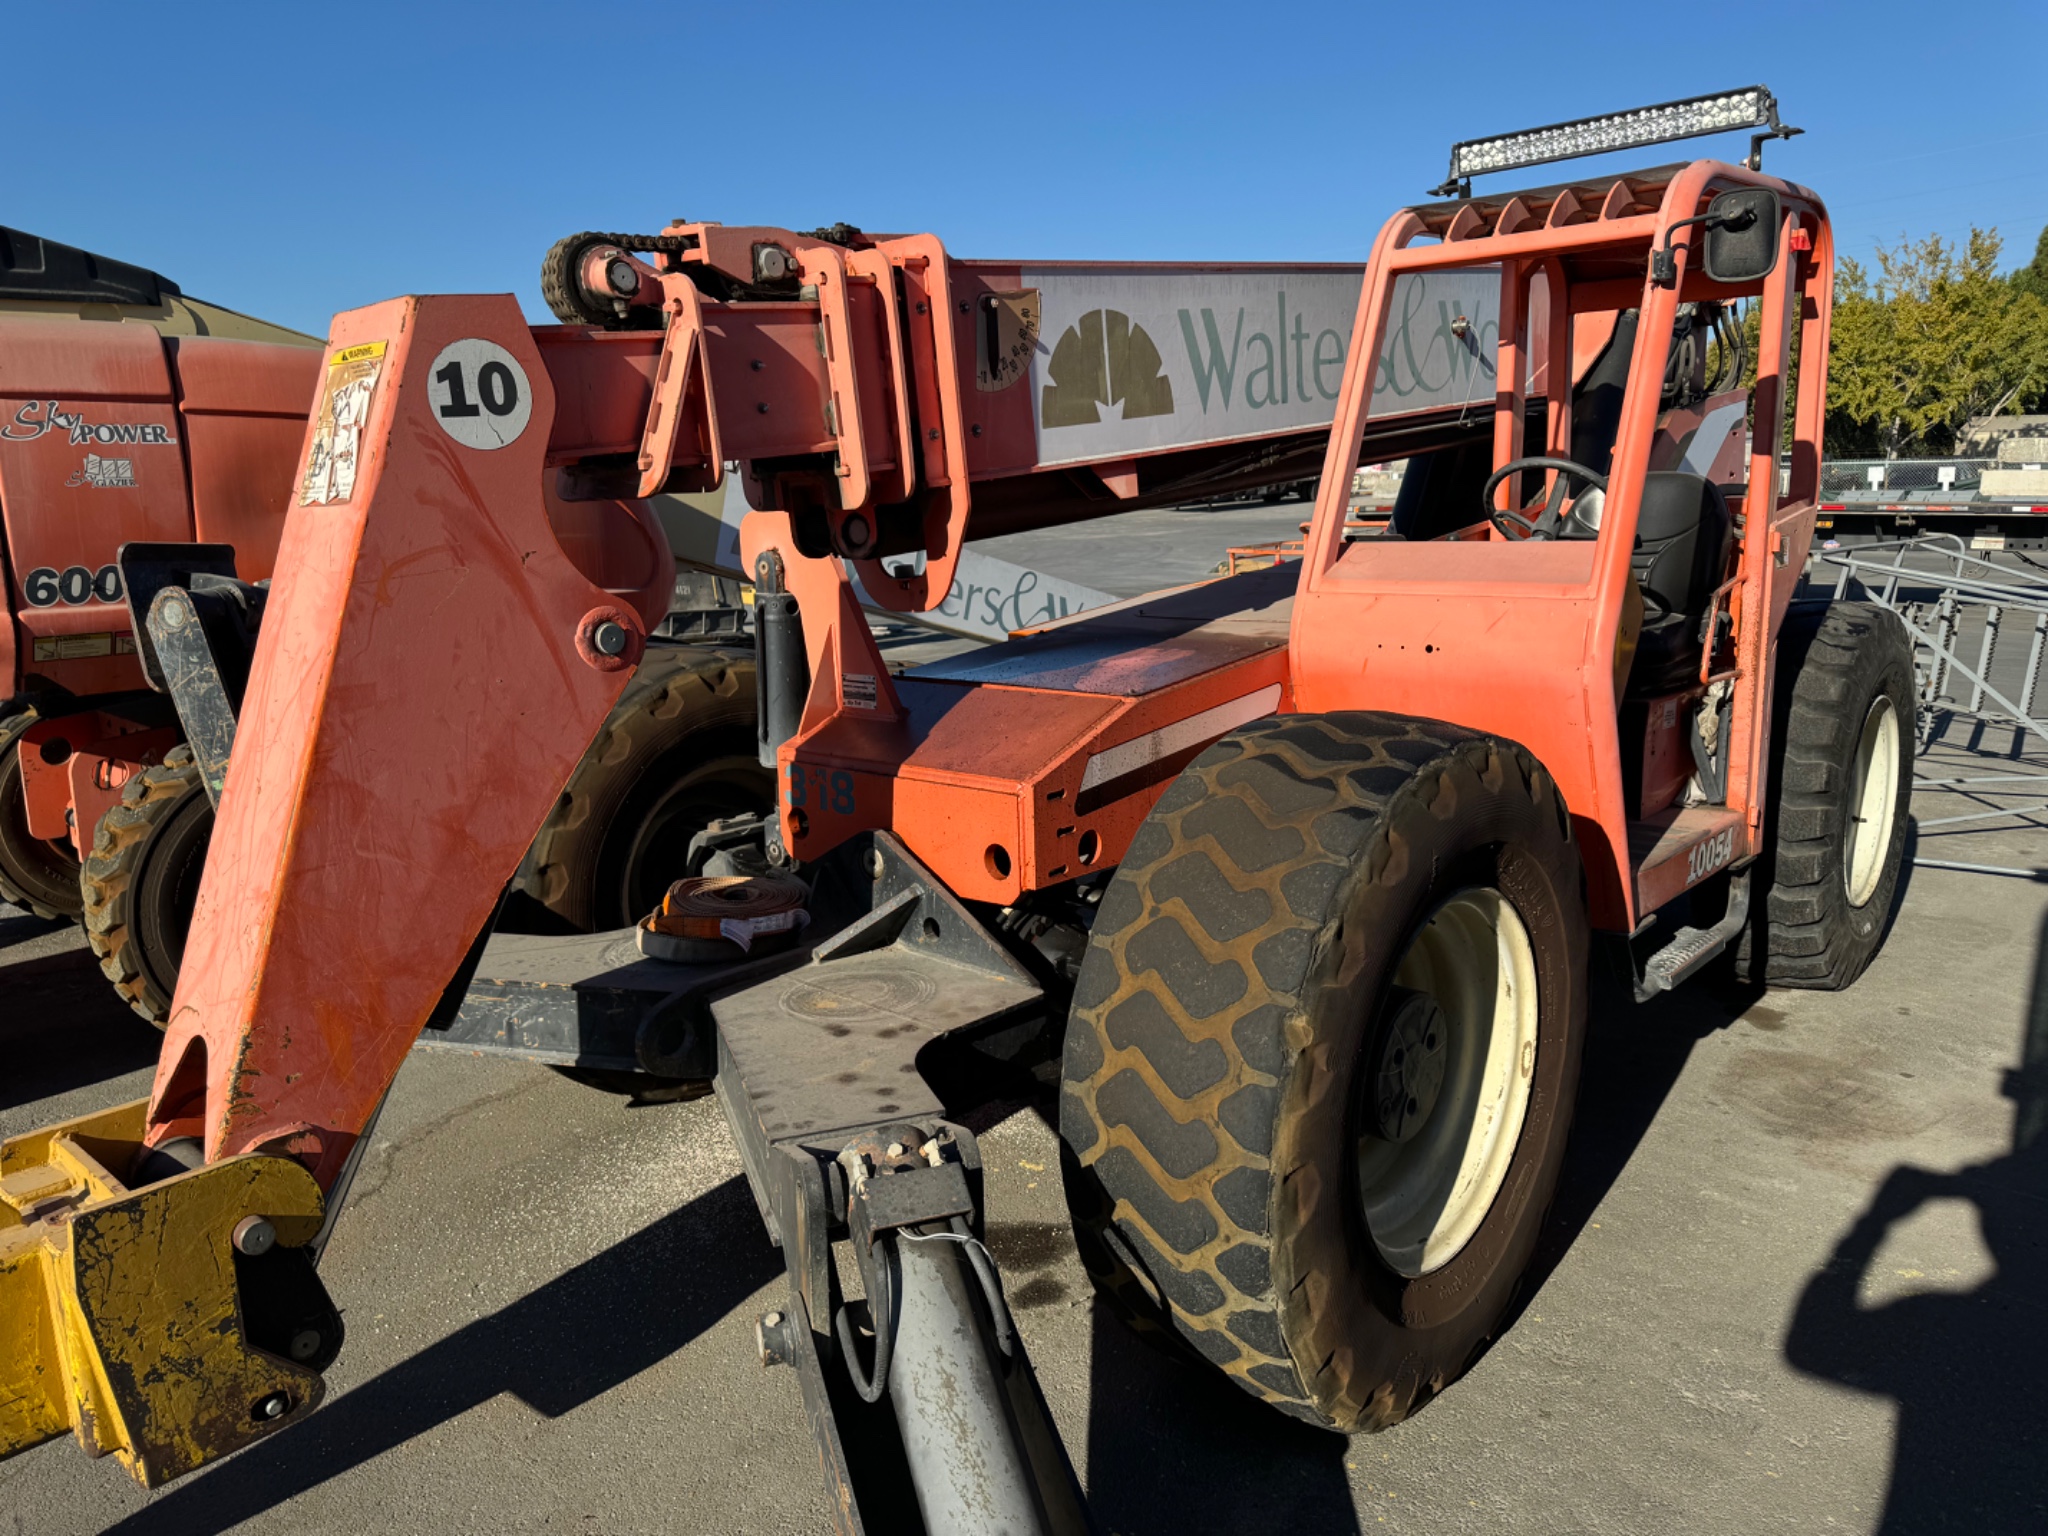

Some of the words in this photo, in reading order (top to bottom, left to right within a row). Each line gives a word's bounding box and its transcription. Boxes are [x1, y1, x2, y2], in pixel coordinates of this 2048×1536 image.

[435, 360, 519, 418] 10
[24, 564, 125, 608] 600
[785, 762, 856, 815] 318
[1686, 826, 1733, 885] 10054
